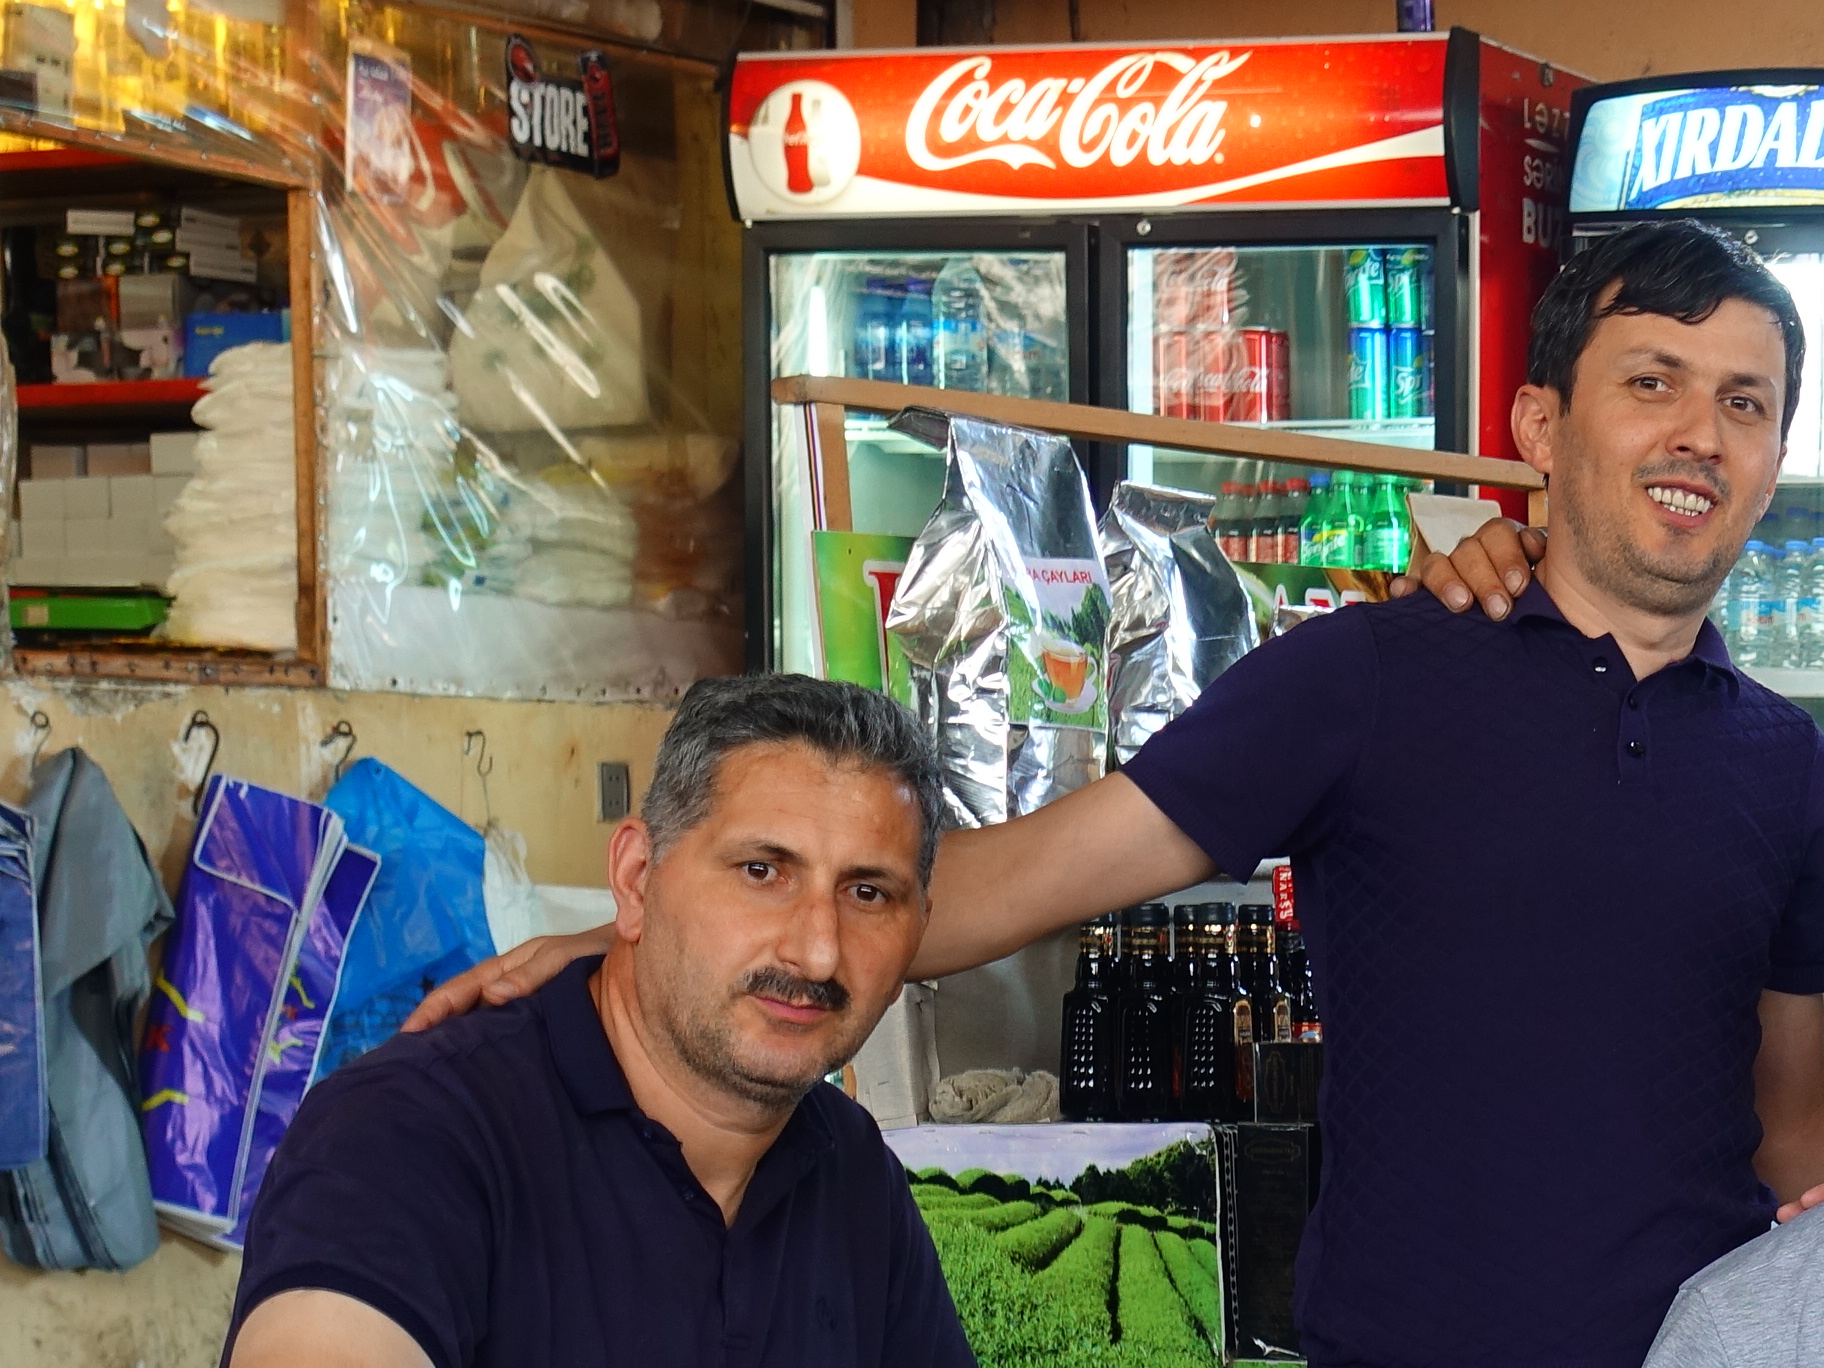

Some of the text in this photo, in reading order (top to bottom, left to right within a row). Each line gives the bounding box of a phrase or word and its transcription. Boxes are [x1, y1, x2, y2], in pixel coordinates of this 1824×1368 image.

[510, 79, 590, 158] STORE
[905, 50, 1253, 172] Coca-Cola
[1041, 567, 1093, 586] ÇAYLARI
